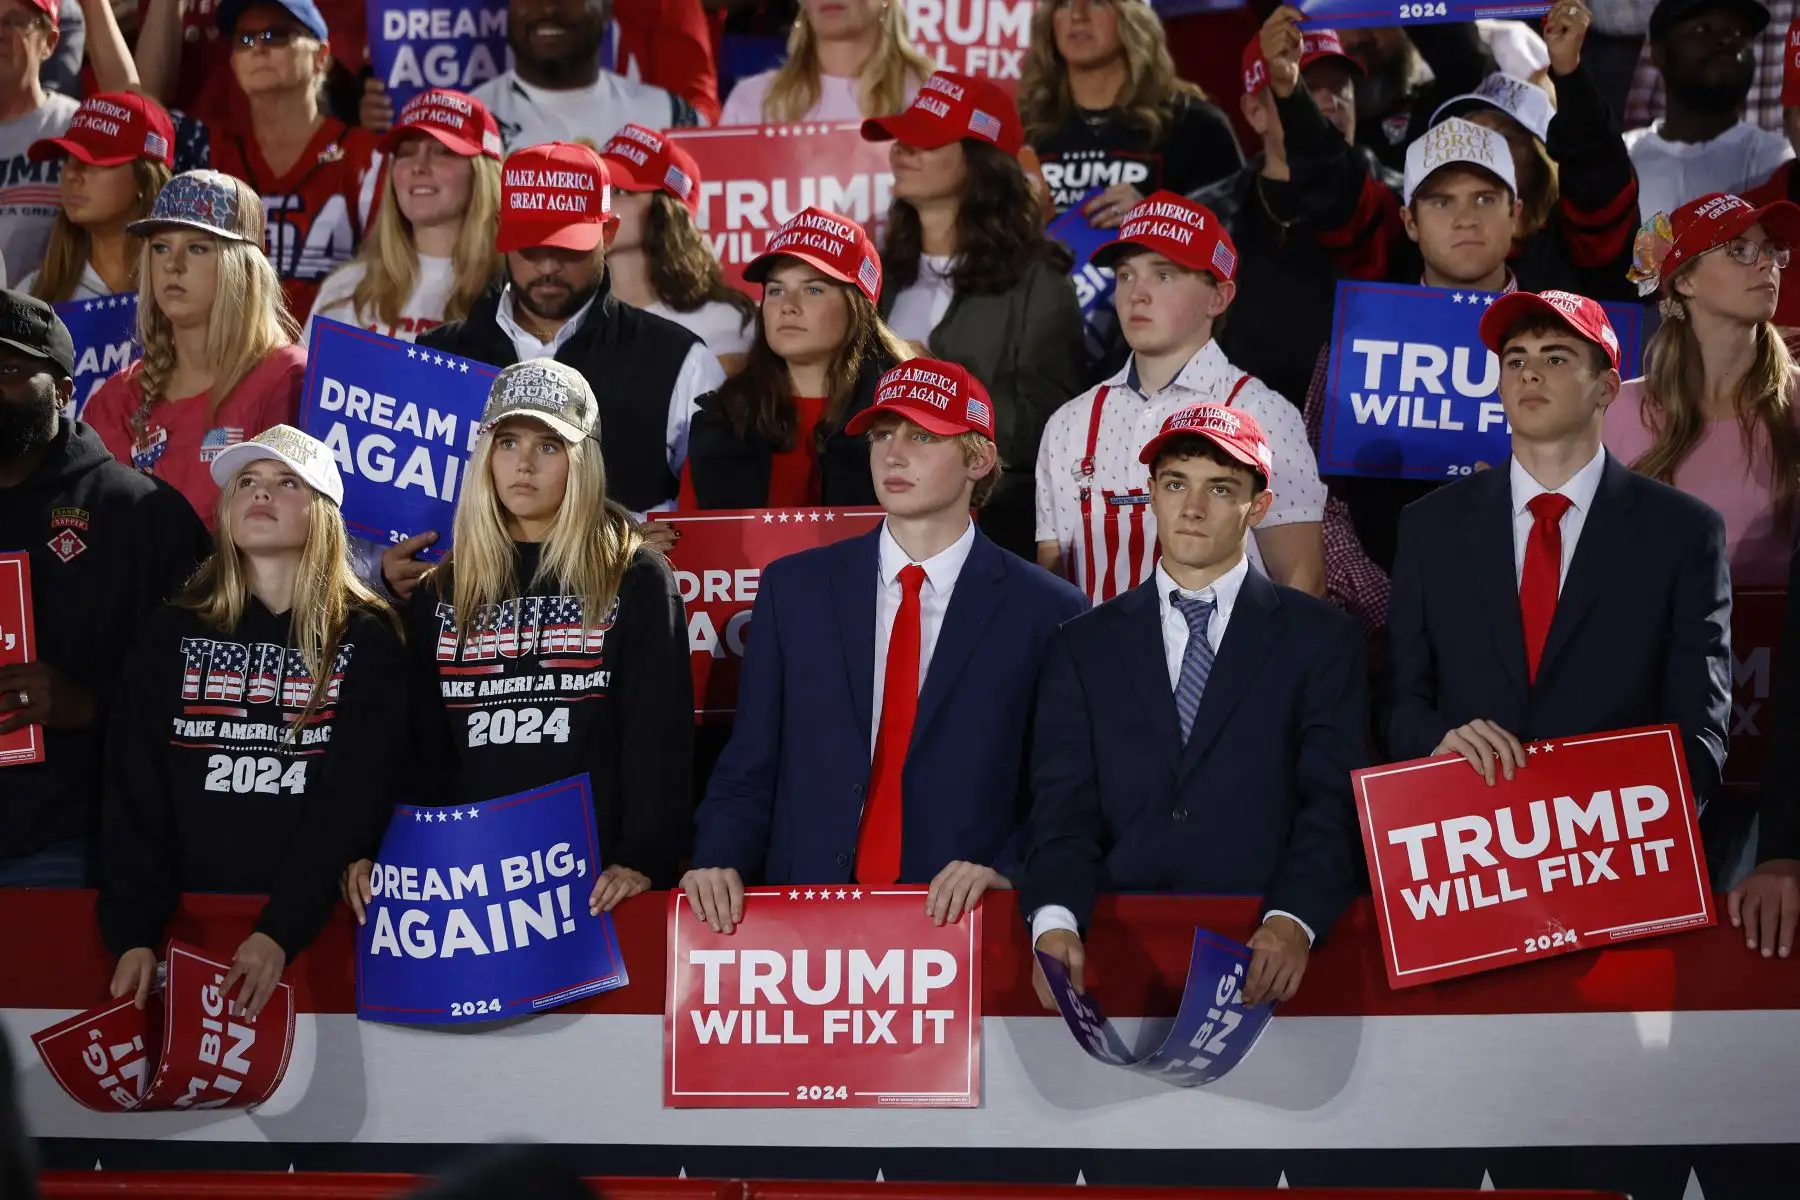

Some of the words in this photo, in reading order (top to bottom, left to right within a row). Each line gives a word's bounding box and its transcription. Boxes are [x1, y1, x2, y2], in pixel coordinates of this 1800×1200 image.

[906, 0, 1033, 48] RUM
[1400, 3, 1447, 18] 2024
[965, 46, 1024, 80] FIX
[84, 98, 131, 123] AMERICA
[423, 93, 473, 117] AMERICA
[429, 110, 464, 129] AGAIN
[85, 117, 120, 137] AGAIN
[506, 169, 535, 186] MAKE
[536, 170, 595, 191] AMERICA
[1040, 160, 1148, 189] RUMP
[510, 192, 545, 210] GREAT
[547, 194, 587, 212] AGAIN
[1145, 202, 1205, 231] AMERICA
[796, 214, 855, 243] AMERICA
[1119, 221, 1150, 241] GREAT
[1149, 221, 1194, 246] AGAIN
[800, 232, 844, 257] AGAIN
[507, 366, 570, 386] JESUS
[901, 367, 958, 397] AMERICA
[1353, 338, 1500, 398] TRU
[503, 385, 569, 406] TRUMP
[515, 378, 531, 386] MY
[532, 378, 568, 394] SAVIOR
[877, 385, 906, 406] GREAT
[907, 385, 950, 411] AGAIN
[319, 376, 458, 446] DREAM
[1197, 407, 1241, 429] AMERICA
[1350, 392, 1464, 431] WILL
[1203, 418, 1237, 437] AGAIN
[324, 421, 471, 503] AGAI
[674, 568, 760, 603] DRE
[440, 681, 475, 698] AKE
[478, 674, 555, 697] AMERICA
[560, 671, 612, 691] BACK!
[173, 717, 216, 737] TAKE
[301, 726, 333, 745] BAC
[468, 707, 571, 748] 2024
[204, 754, 308, 795] 2024
[1388, 784, 1670, 882] TRUMP
[369, 863, 489, 901] DREAM
[500, 842, 586, 892] BIG,
[1400, 868, 1528, 921] WILL
[1538, 846, 1620, 893] FIX
[1630, 838, 1675, 877] IT
[370, 884, 576, 959] AGAIN!
[1524, 928, 1578, 953] 2024
[690, 949, 958, 1006] TRUMP
[199, 973, 226, 1066] BIG,
[451, 999, 502, 1016] 2024
[1189, 963, 1244, 1050] BIG,
[690, 1010, 809, 1044] WILL
[823, 1010, 898, 1044] FIX
[912, 1010, 954, 1044] IT
[796, 1085, 848, 1100] 2024
